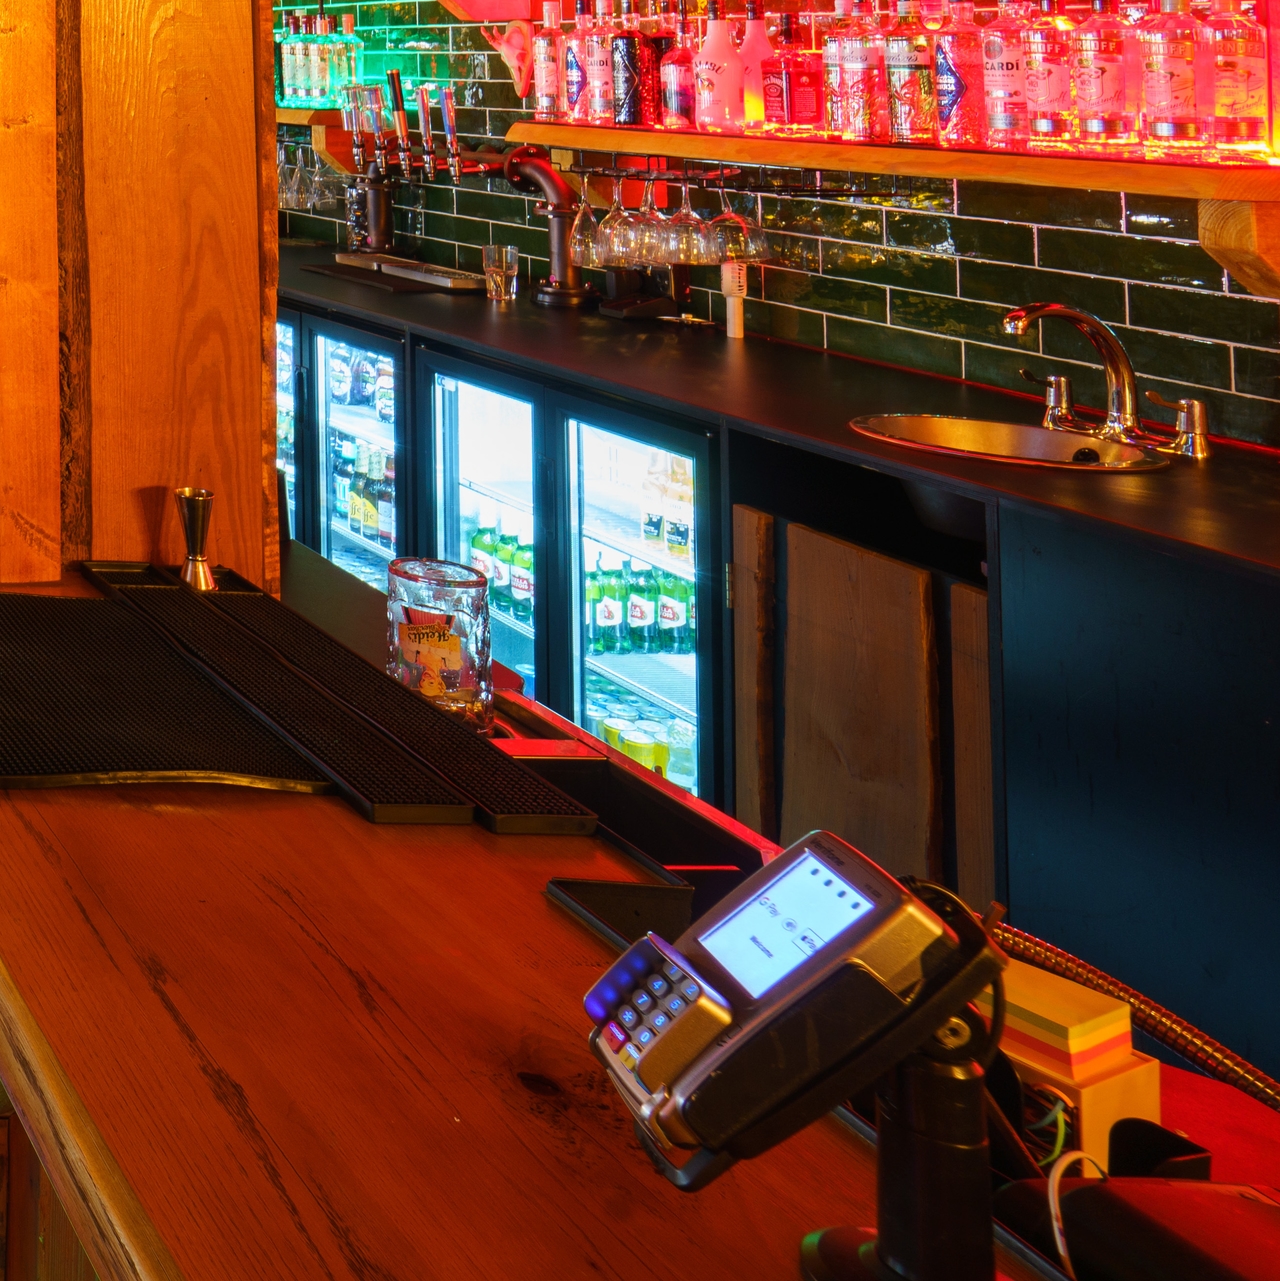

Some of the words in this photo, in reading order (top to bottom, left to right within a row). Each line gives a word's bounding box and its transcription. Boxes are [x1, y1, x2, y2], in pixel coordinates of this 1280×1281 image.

[1141, 43, 1186, 55] IRNOFF
[1215, 42, 1261, 53] RNOFF
[985, 59, 1020, 71] CARDÍ
[351, 502, 361, 516] ffe
[364, 509, 374, 522] ffe
[407, 629, 450, 644] Heidi's
[810, 837, 845, 867] Verifone
[766, 902, 781, 918] Pay
[749, 935, 774, 959] Welcome
[652, 980, 663, 990] 4
[685, 984, 697, 995] 2
[638, 994, 649, 1004] 7
[670, 999, 681, 1011] 5
[655, 1015, 665, 1026] 8
[641, 1031, 651, 1042] 0
